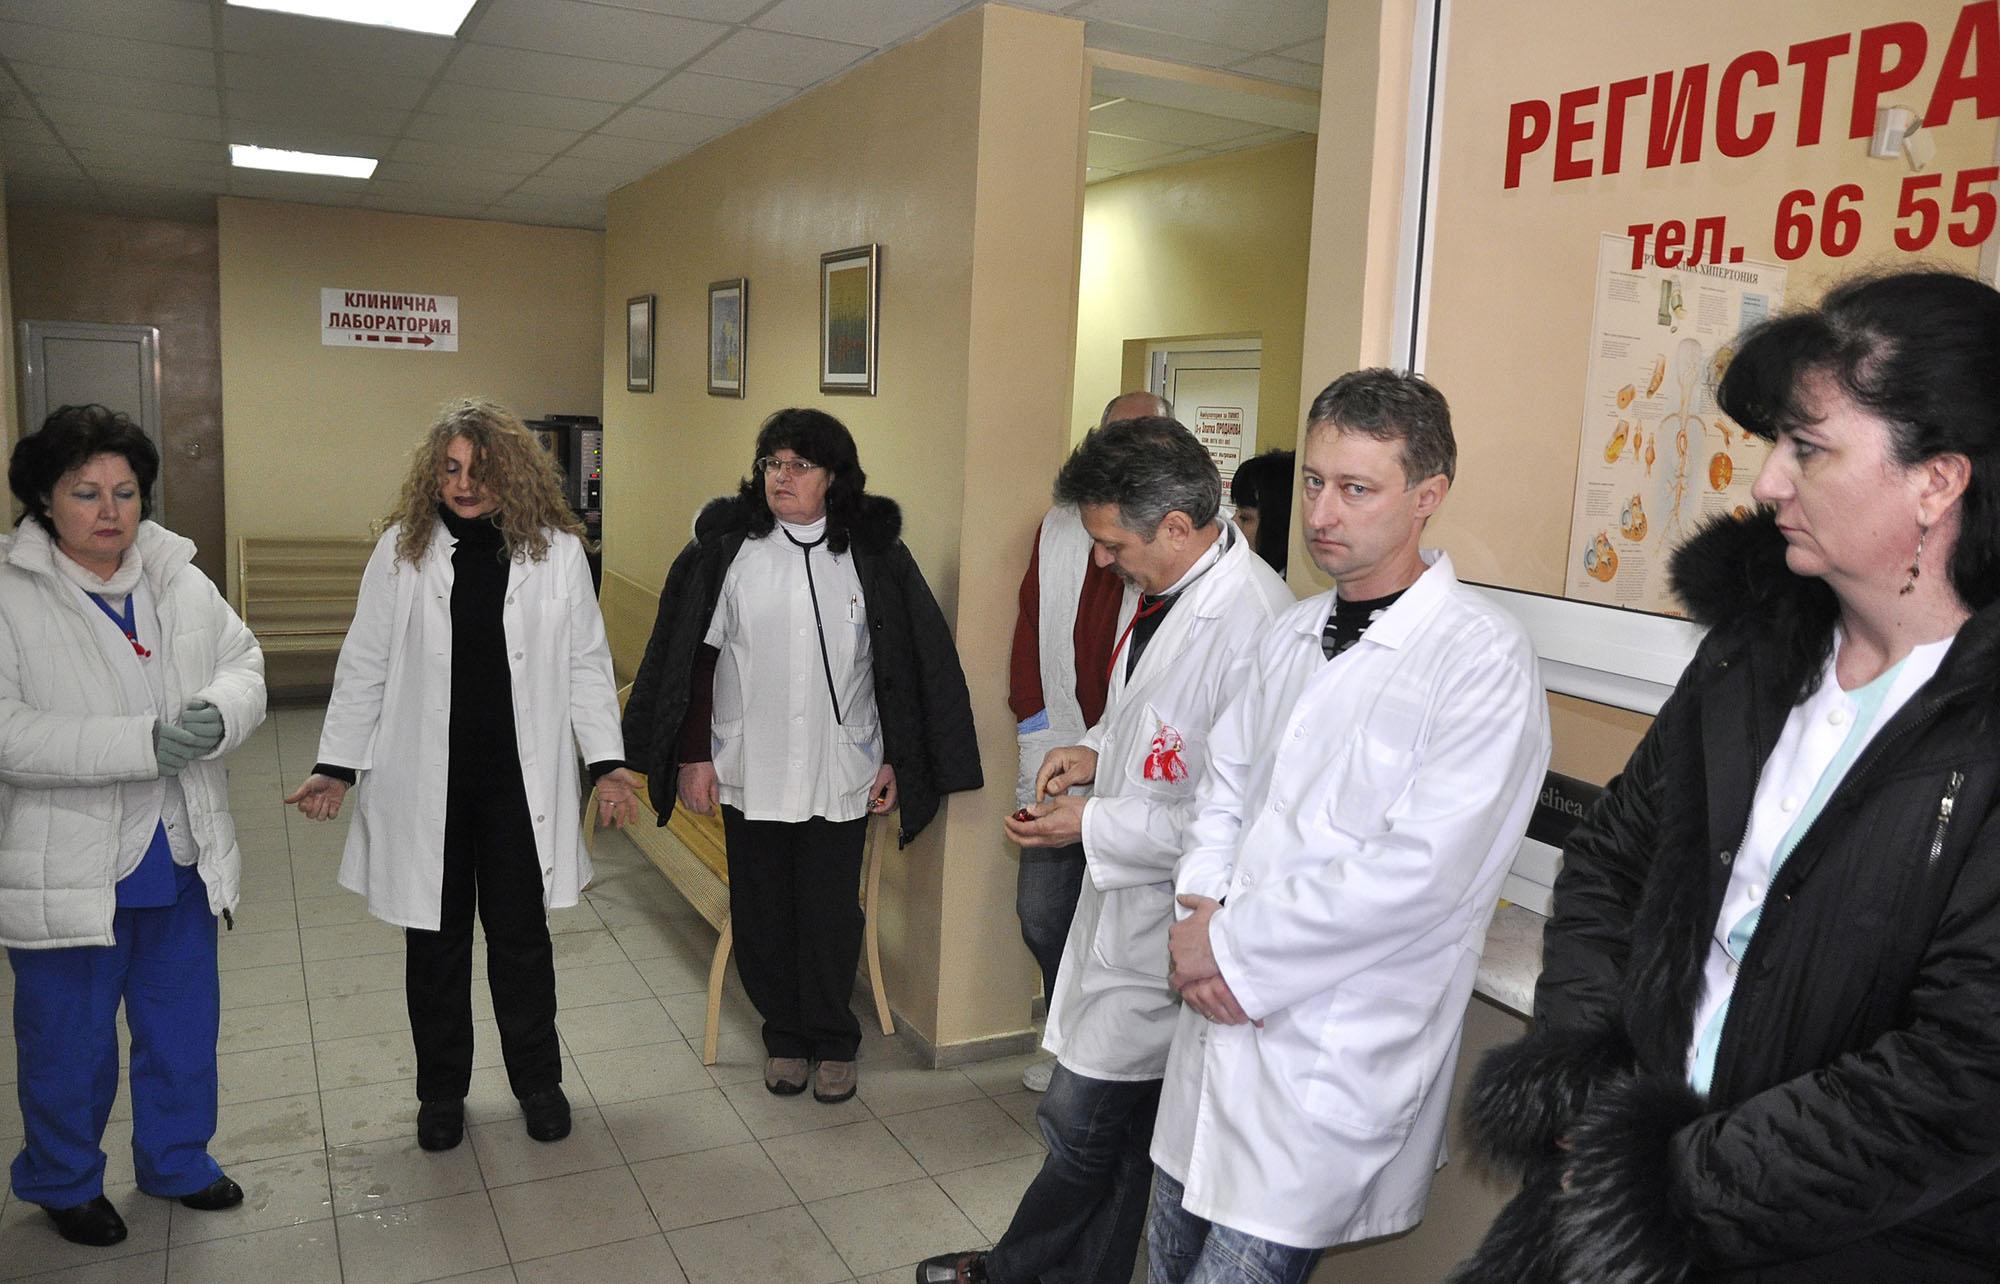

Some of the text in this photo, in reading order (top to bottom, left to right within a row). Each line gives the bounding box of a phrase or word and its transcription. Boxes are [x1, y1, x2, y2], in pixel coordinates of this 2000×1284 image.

[1503, 0, 2000, 190] РЕГИСТРА
[1627, 166, 1999, 271] тел. 66 55
[1699, 263, 1759, 285] ХИПЕРТОНИЯ
[344, 291, 437, 313] КЛИНИЧНА
[328, 312, 451, 333] ЛАБОРАТОРИЯ
